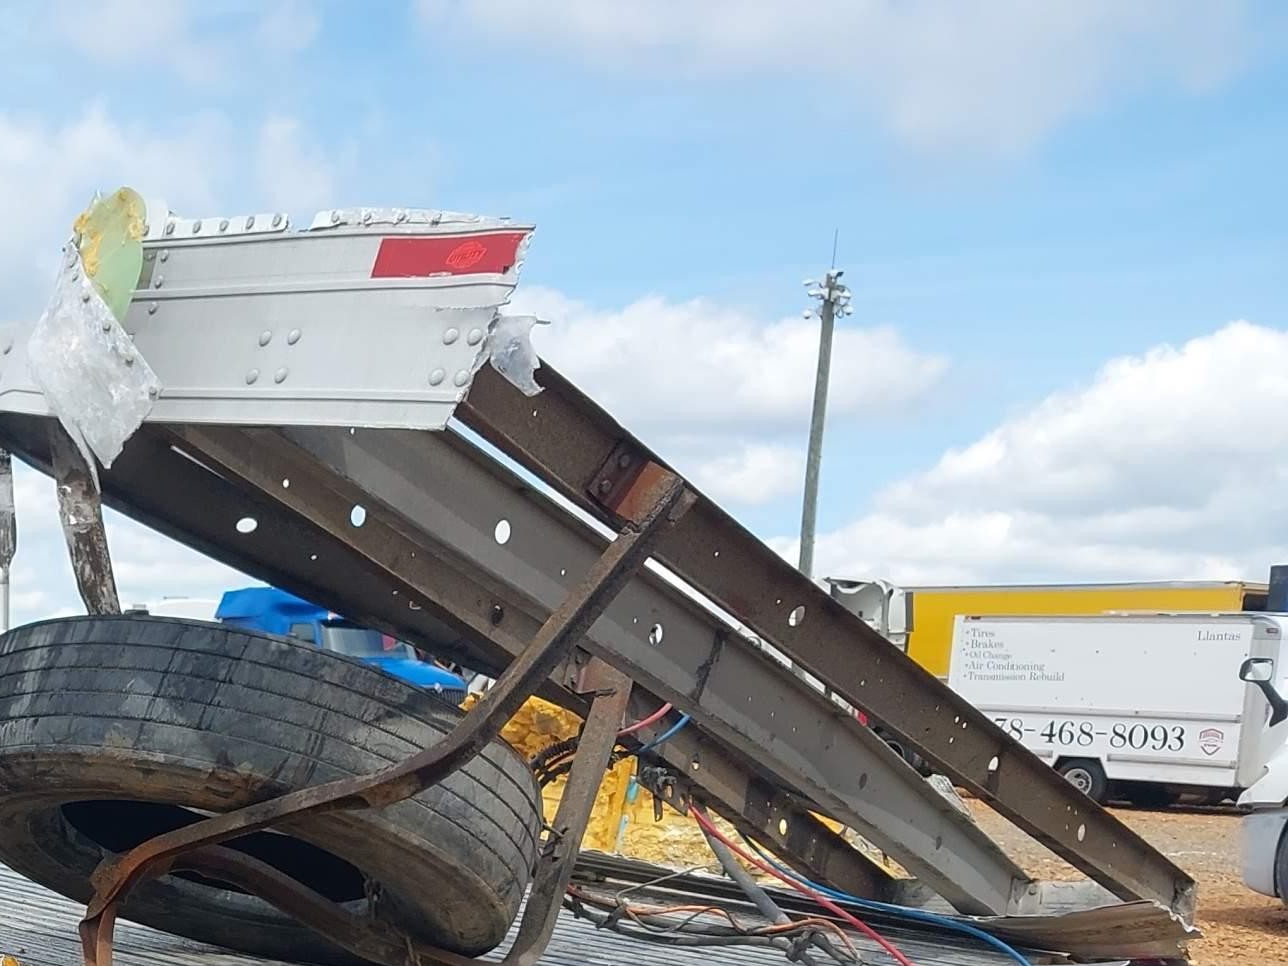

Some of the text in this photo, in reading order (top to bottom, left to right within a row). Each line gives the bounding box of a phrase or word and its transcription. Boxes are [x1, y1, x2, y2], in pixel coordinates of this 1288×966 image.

[970, 627, 995, 638] Tires
[1197, 630, 1241, 641] Llantas
[970, 639, 1004, 649] Brakes
[982, 650, 1012, 661] Change
[968, 661, 1045, 672] Air Conditioning
[968, 671, 1065, 681] Transmission Rebuild
